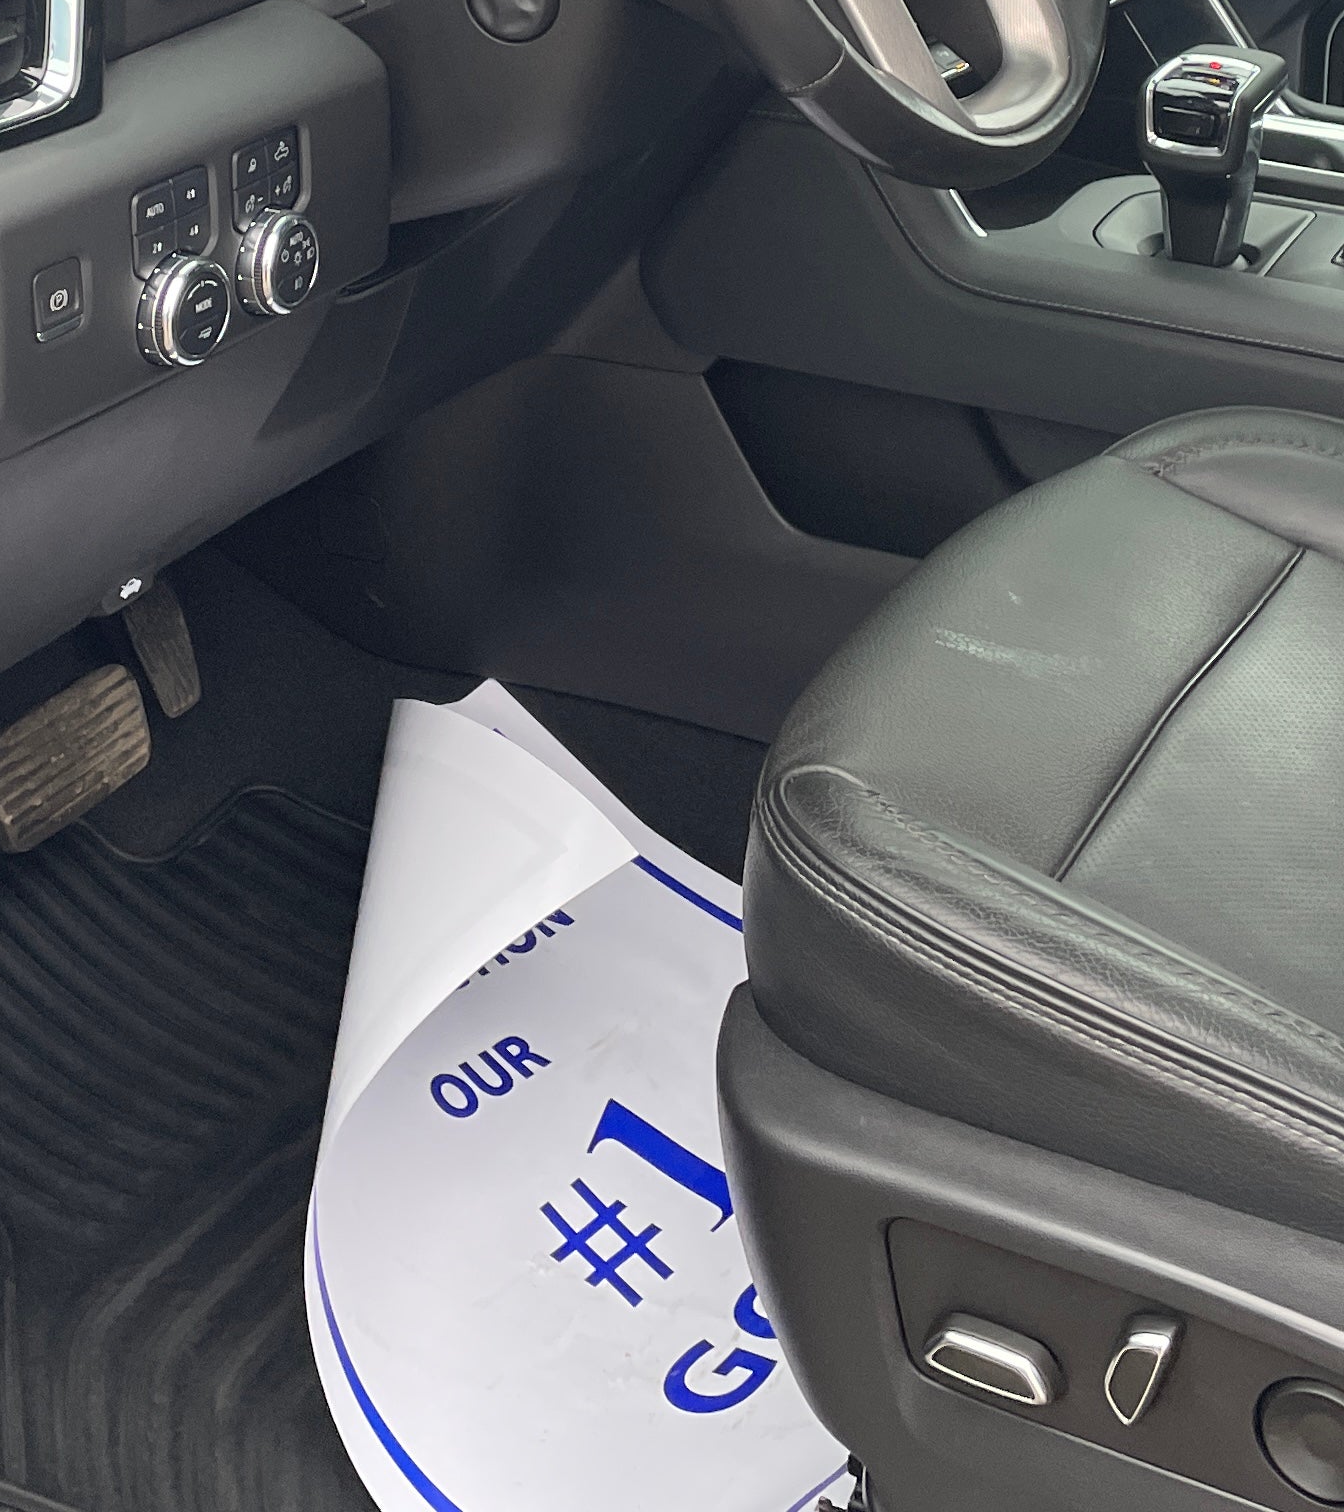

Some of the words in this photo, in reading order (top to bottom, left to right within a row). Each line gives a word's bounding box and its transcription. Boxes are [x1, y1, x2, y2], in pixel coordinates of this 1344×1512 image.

[146, 202, 165, 218] AUTO
[195, 297, 212, 314] MODE
[430, 1035, 552, 1118] OUR
[539, 1097, 734, 1308] #1
